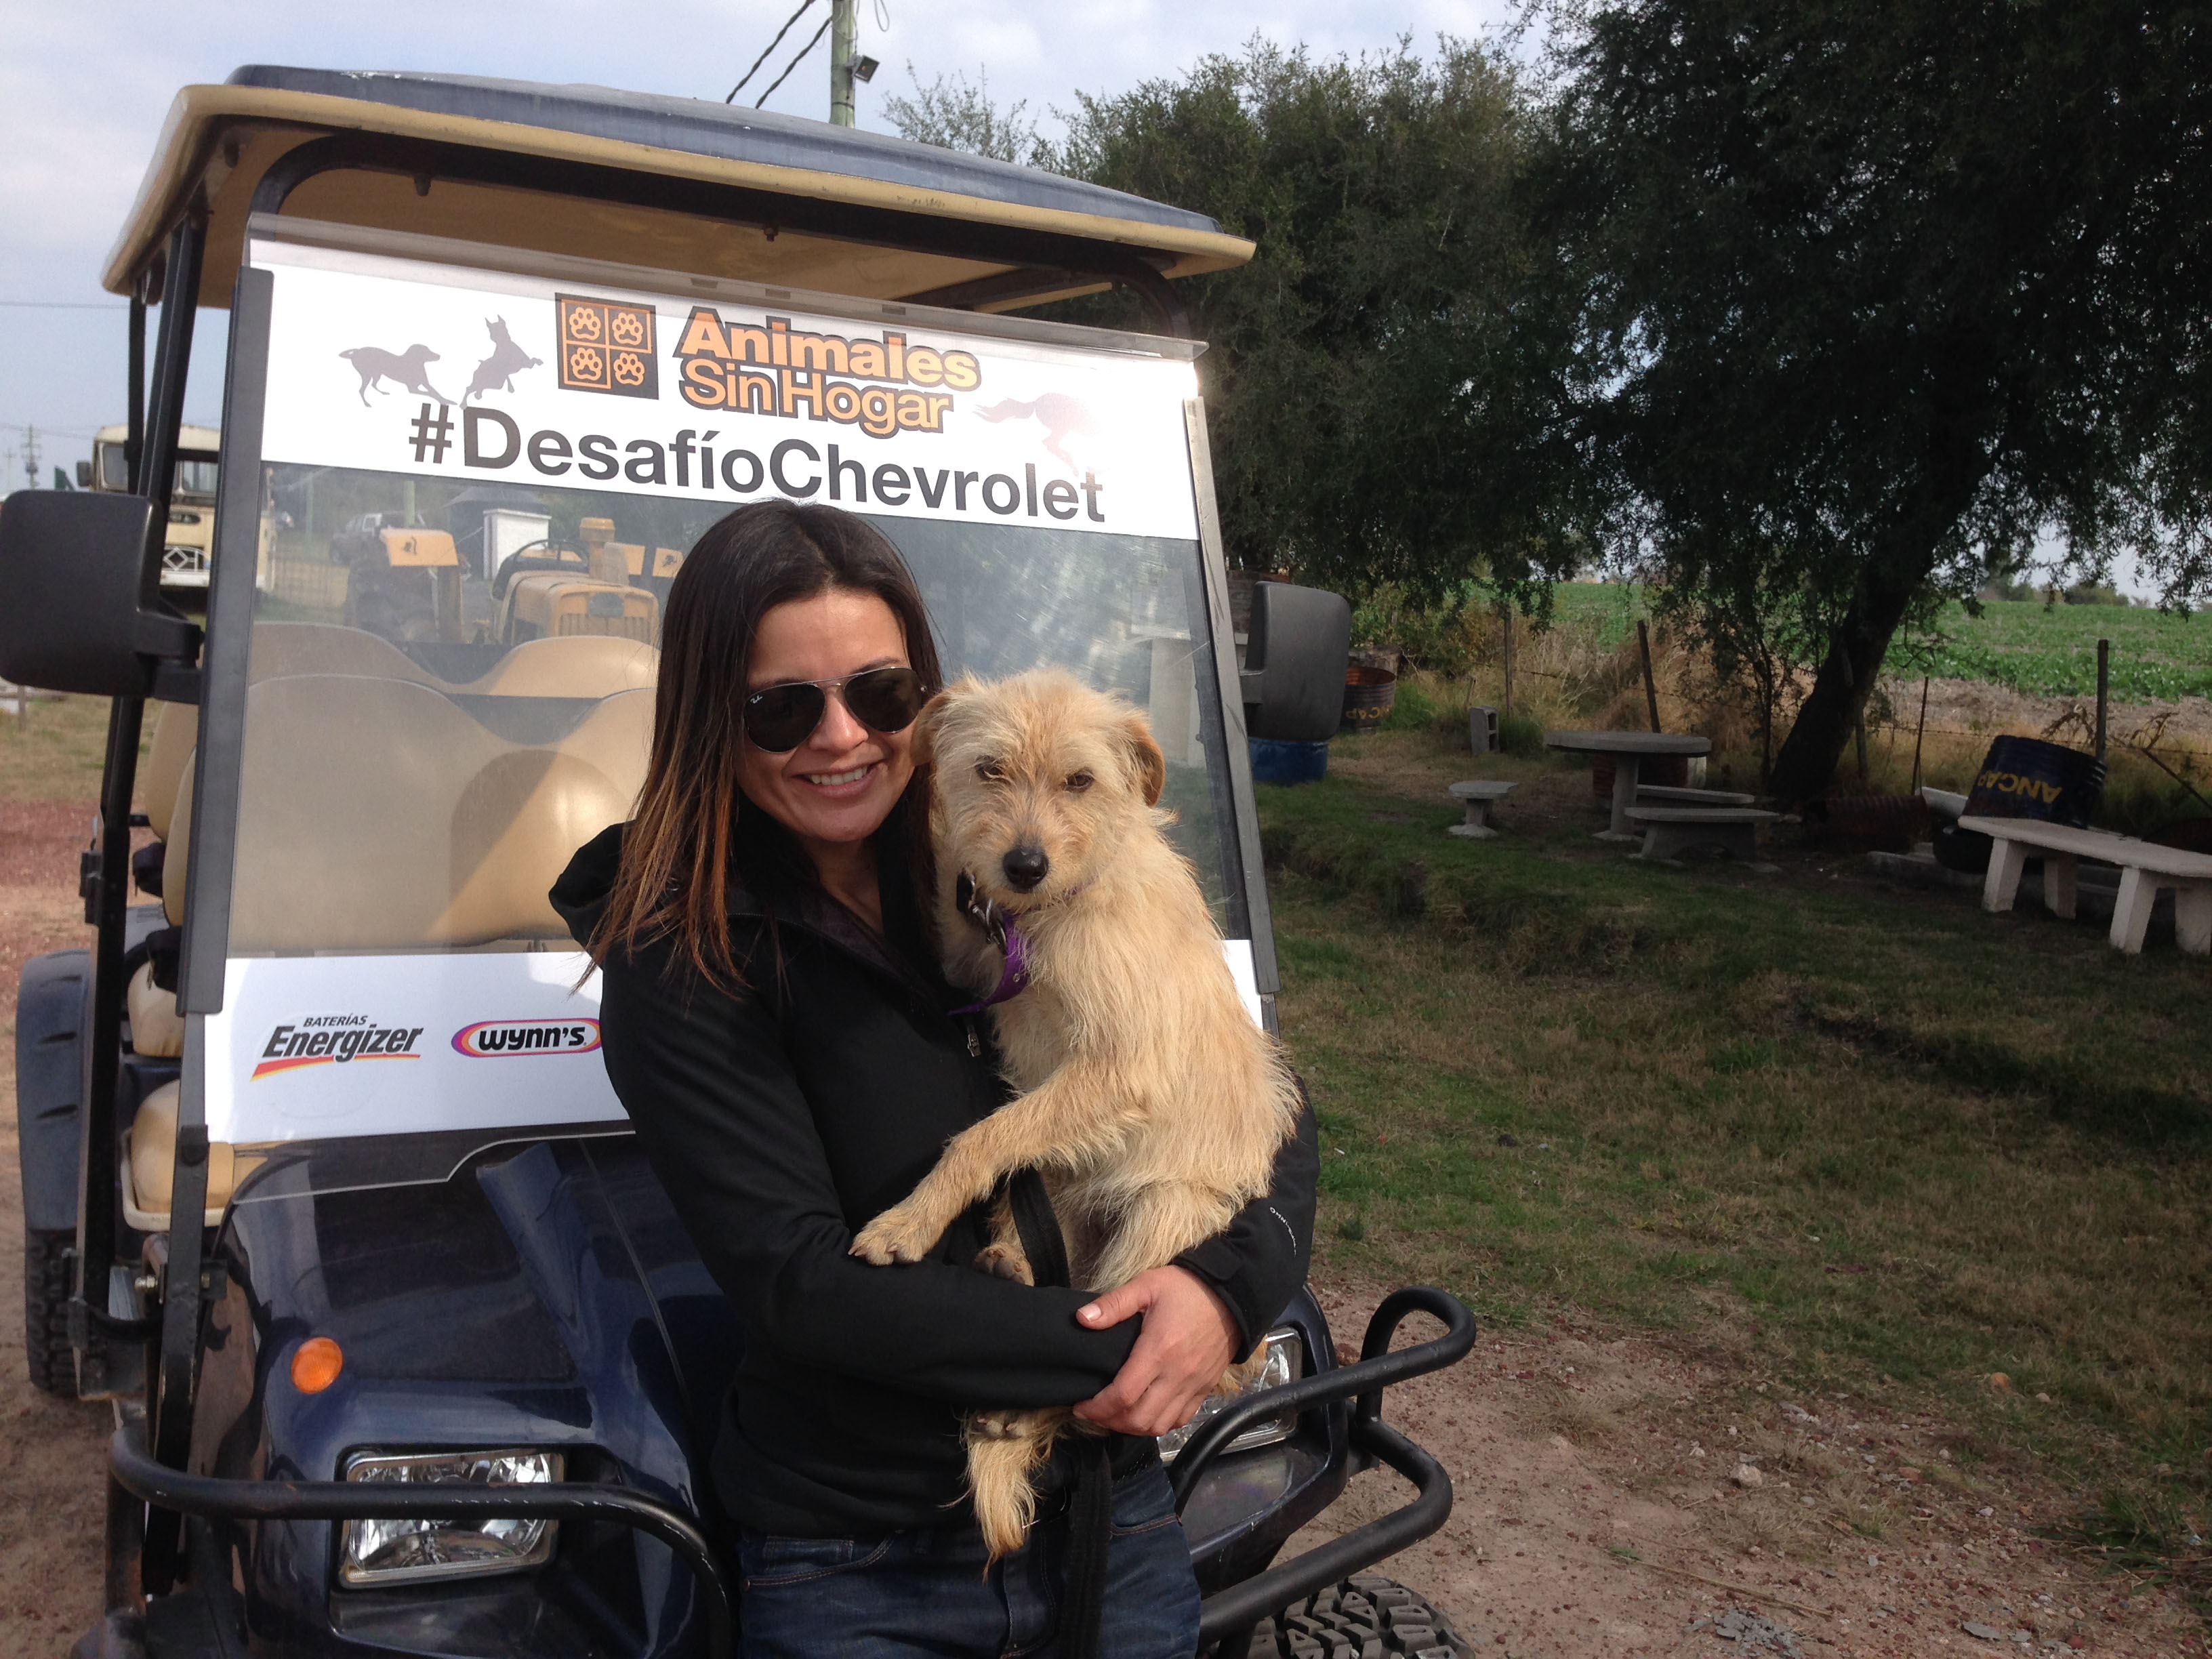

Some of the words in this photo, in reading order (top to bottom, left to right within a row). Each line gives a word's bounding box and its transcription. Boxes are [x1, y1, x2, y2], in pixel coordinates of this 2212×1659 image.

[674, 306, 981, 392] Animales
[409, 403, 1106, 523] #DesafíoChevrolet
[1978, 771, 2063, 804] ANCAP
[303, 1012, 368, 1027] BATERÍAS
[262, 1023, 424, 1063] Energizer
